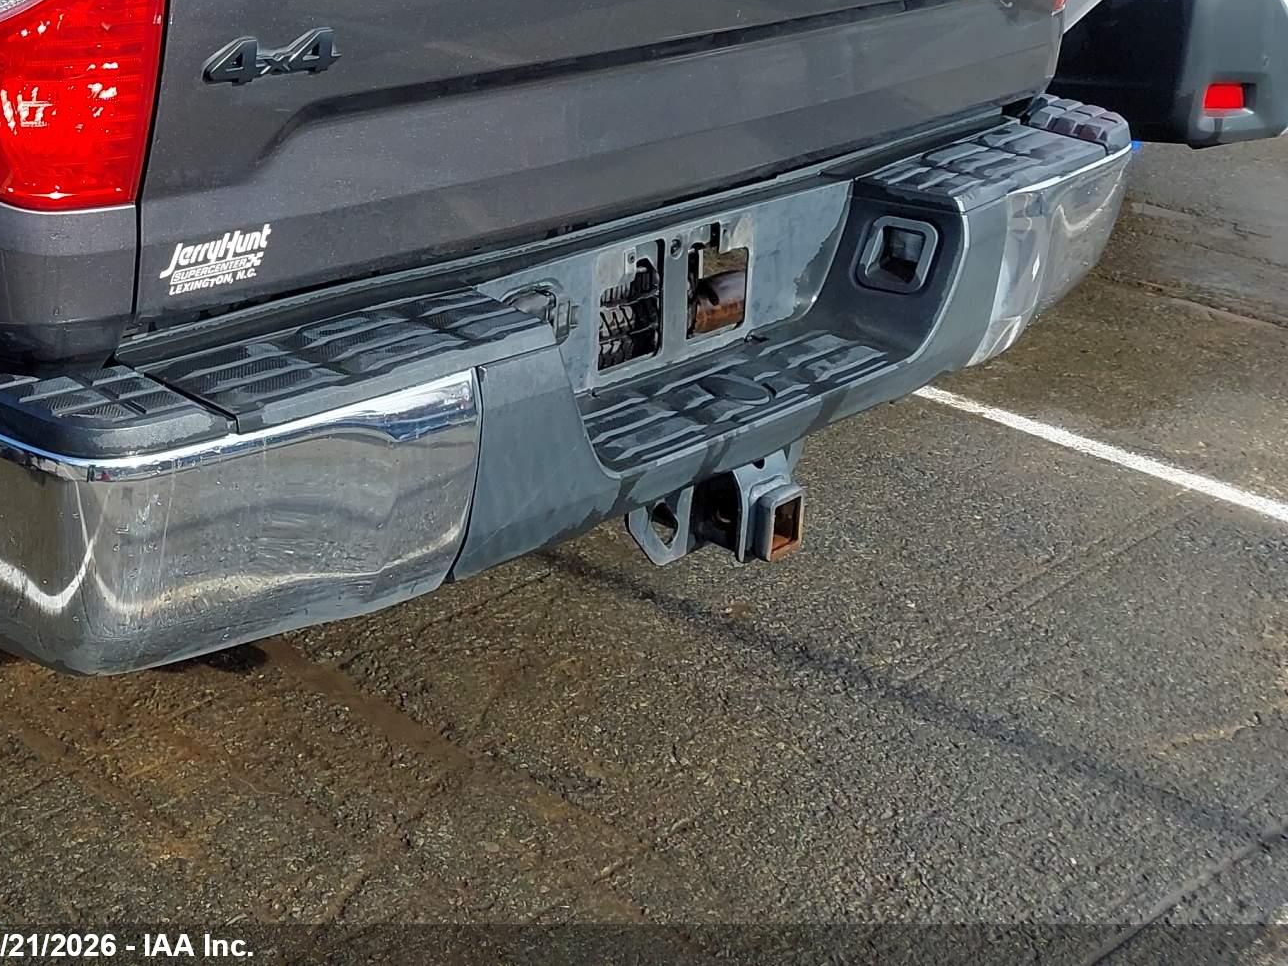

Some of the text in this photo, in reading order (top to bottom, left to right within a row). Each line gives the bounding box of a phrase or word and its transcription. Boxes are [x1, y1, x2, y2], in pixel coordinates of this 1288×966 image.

[168, 268, 257, 296] LEXINGTON, N.C.
[173, 257, 249, 282] SUPERCENTER
